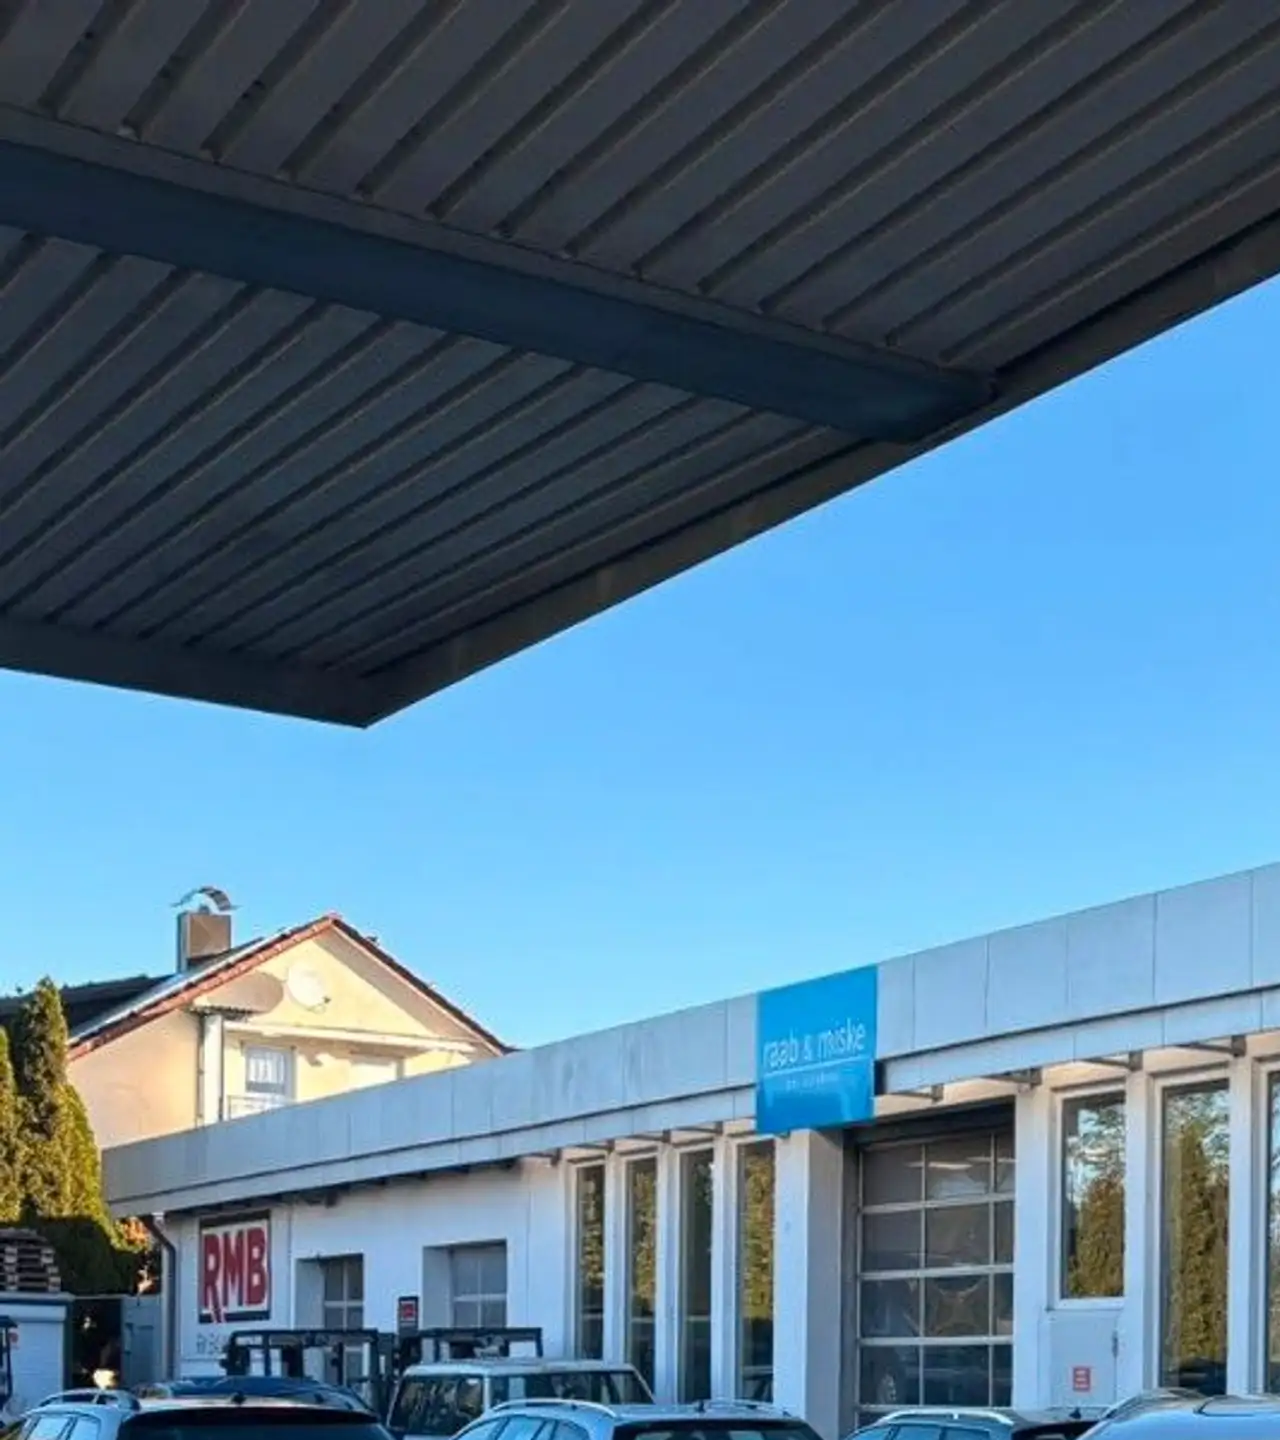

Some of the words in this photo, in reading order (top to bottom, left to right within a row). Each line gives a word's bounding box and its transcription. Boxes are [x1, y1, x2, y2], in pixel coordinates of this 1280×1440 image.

[763, 1029, 799, 1069] raab
[818, 1018, 866, 1060] miske
[204, 1228, 266, 1323] RMB
